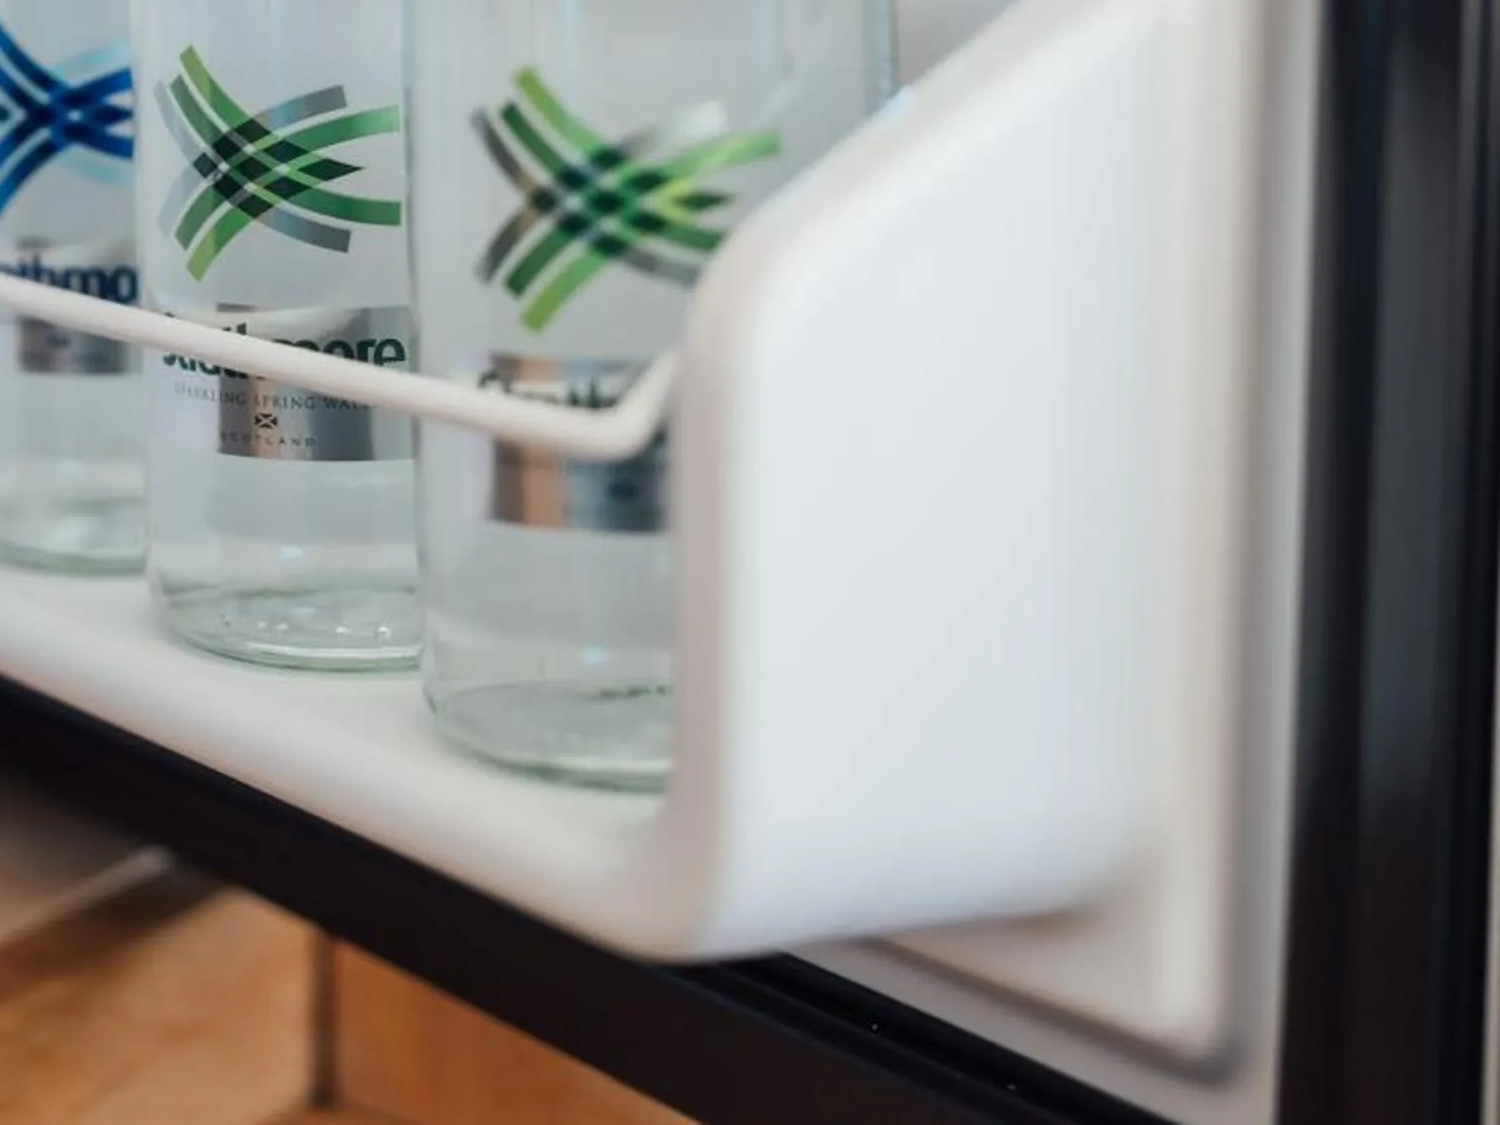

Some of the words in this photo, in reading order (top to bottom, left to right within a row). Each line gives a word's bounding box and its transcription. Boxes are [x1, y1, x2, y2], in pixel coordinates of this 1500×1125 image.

[252, 392, 316, 411] SPRING
[321, 395, 369, 411] WAT
[219, 431, 317, 447] SCOTLAND
